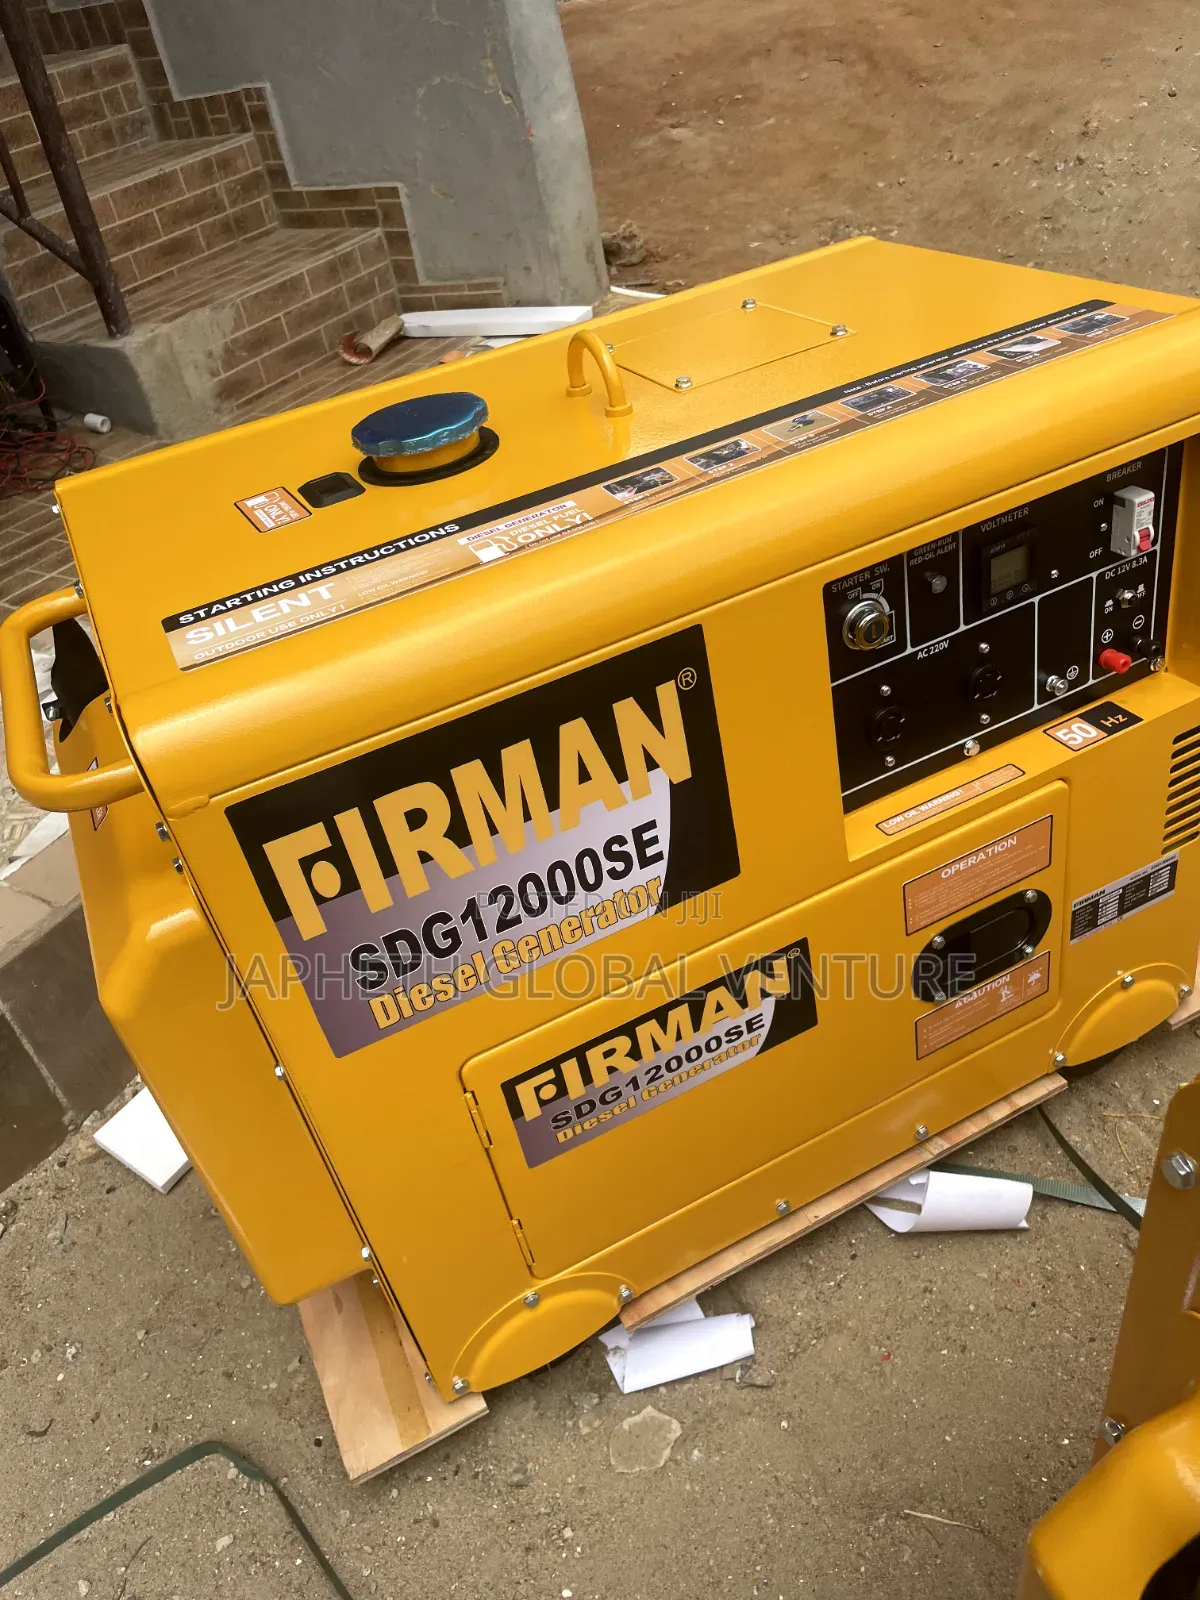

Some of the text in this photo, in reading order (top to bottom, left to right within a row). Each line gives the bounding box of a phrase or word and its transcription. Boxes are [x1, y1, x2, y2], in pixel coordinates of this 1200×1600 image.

[1106, 462, 1142, 482] BREAKER
[1093, 498, 1104, 508] ON
[466, 502, 568, 542] DIESEL GENERATOR
[509, 507, 584, 536] DIESEL FUEL
[517, 512, 594, 544] ONLY!
[980, 507, 1029, 532] VOLTMETER
[914, 534, 952, 557] GREEN-RUN
[936, 542, 957, 556] ALERT
[1089, 547, 1103, 559] OFF
[179, 579, 296, 625] STARTING
[299, 523, 460, 584] INSTRUCTIONS
[831, 563, 890, 593] STARTER SW.
[1105, 555, 1148, 580] DC 12V 8.3A
[847, 590, 860, 600] OFF
[871, 582, 881, 590] ON
[185, 583, 335, 646] SILENT
[1104, 605, 1114, 614] ON
[193, 603, 346, 661] OUTDOOR USE ONLY!
[917, 640, 949, 660] AC 220V
[1055, 722, 1098, 745] 50
[1100, 714, 1128, 728] Hz
[262, 679, 693, 941] FIRMAN
[883, 814, 905, 829] LOW
[904, 806, 921, 818] OIL
[919, 789, 964, 812] WARNING!
[940, 836, 1017, 879] OPERATION
[348, 818, 666, 992] SDG12000SE
[368, 875, 663, 1030] Diesel Generator
[963, 974, 1010, 1004] CAUTION
[515, 955, 791, 1122] FIRMAN
[550, 1012, 765, 1130] SDG12000SE
[556, 1032, 762, 1145] Diesel Generator
